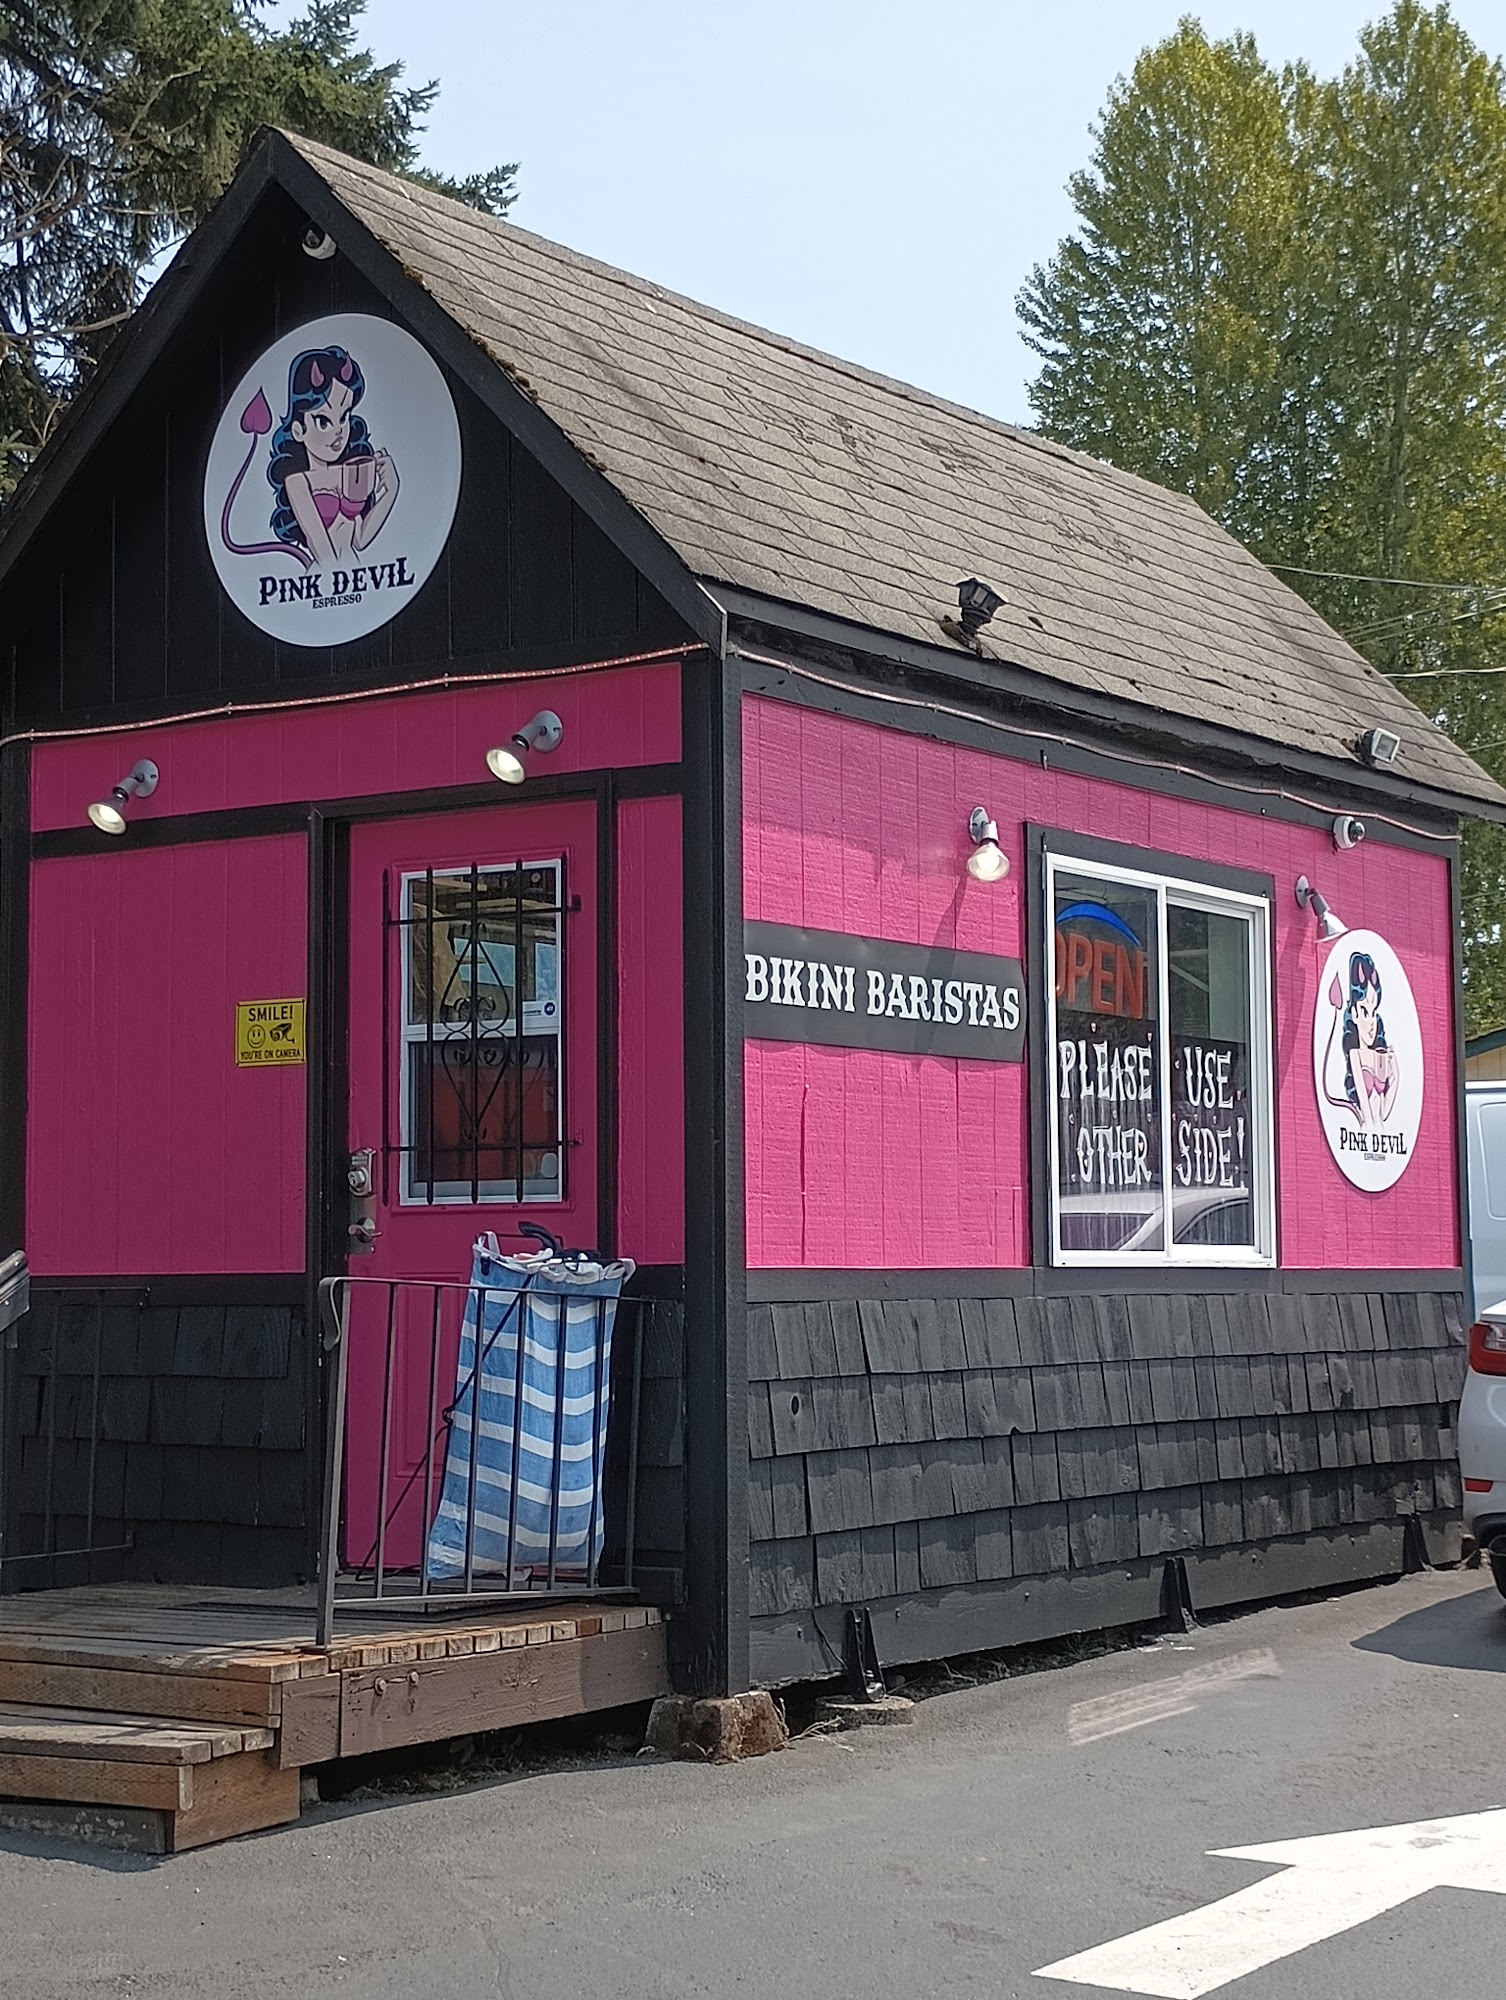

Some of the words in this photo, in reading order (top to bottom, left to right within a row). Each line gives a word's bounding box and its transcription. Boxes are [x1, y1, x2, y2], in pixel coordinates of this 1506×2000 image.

[259, 574, 323, 606] PINK
[333, 557, 415, 595] DEVIL
[312, 593, 362, 609] ESPRESSO
[745, 954, 856, 1012] BIKINI
[867, 970, 1020, 1030] BARISTAS
[248, 1005, 293, 1021] SMILE!
[241, 1050, 262, 1060] YOU'RE
[264, 1049, 274, 1059] ON
[275, 1048, 301, 1058] CAMERA
[1059, 1040, 1152, 1101] PLEASE
[1184, 1047, 1233, 1109] USE
[1077, 1125, 1152, 1185] OTHER
[1176, 1117, 1245, 1190] SIDE!
[1340, 1127, 1368, 1152] PINK
[1372, 1133, 1407, 1155] DEVIL
